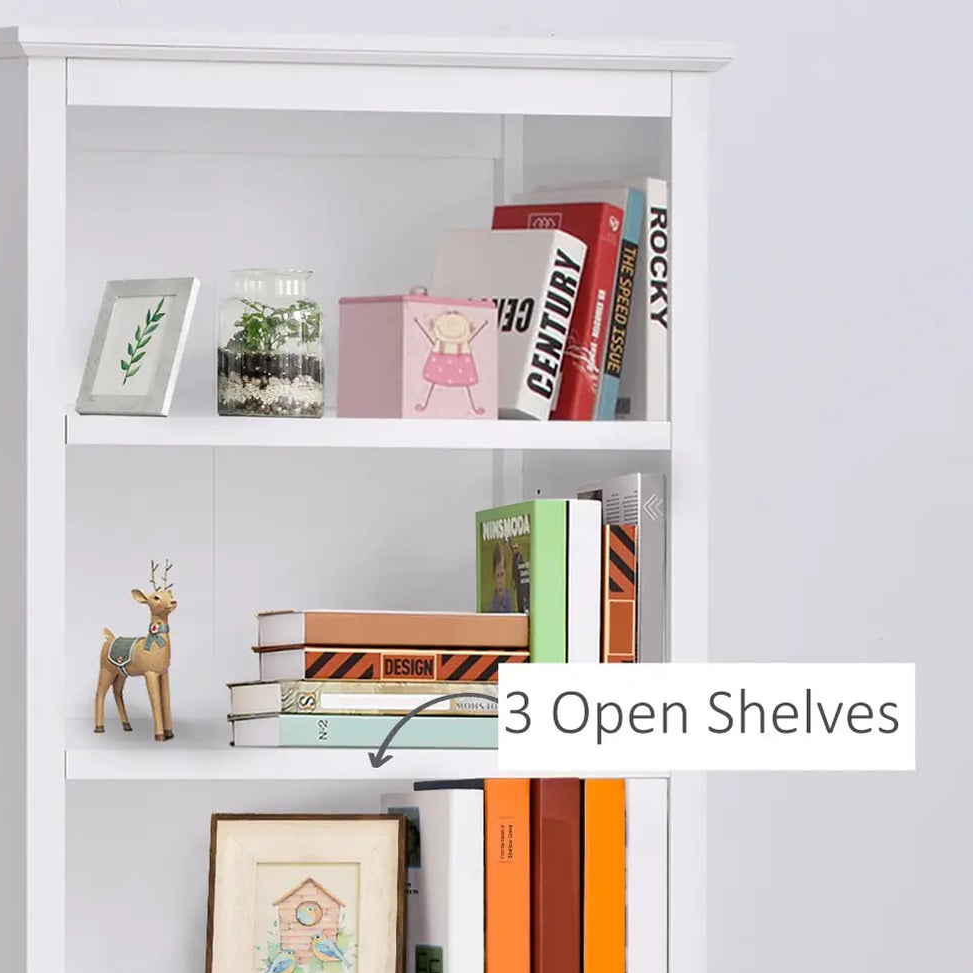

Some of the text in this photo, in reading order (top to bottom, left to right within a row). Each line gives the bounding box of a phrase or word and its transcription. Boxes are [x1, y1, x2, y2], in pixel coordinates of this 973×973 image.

[526, 248, 583, 401] CENTURY
[606, 247, 638, 374] THE SPEED ISSUE
[649, 206, 668, 330] ROCKY
[384, 655, 435, 677] DESIGN
